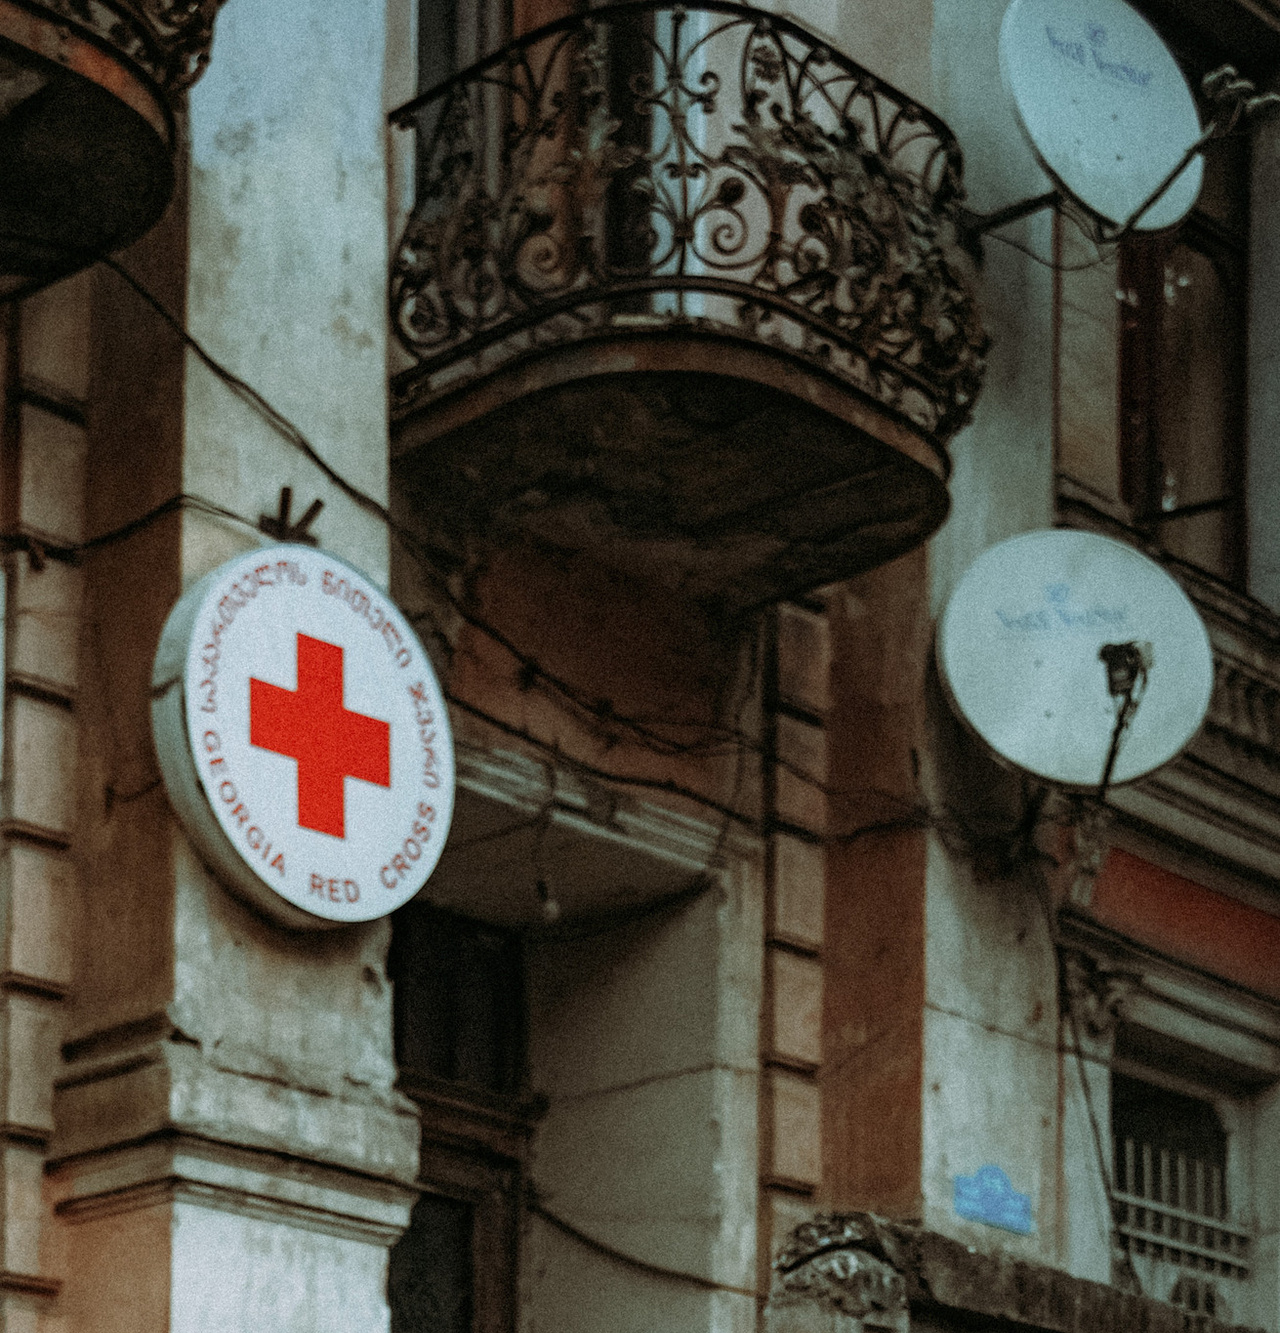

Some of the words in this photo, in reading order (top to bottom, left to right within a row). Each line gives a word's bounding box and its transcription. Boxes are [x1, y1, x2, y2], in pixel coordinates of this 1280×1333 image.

[202, 730, 286, 877] GEORGIA
[308, 873, 360, 903] RED
[379, 801, 437, 890] CROSS
